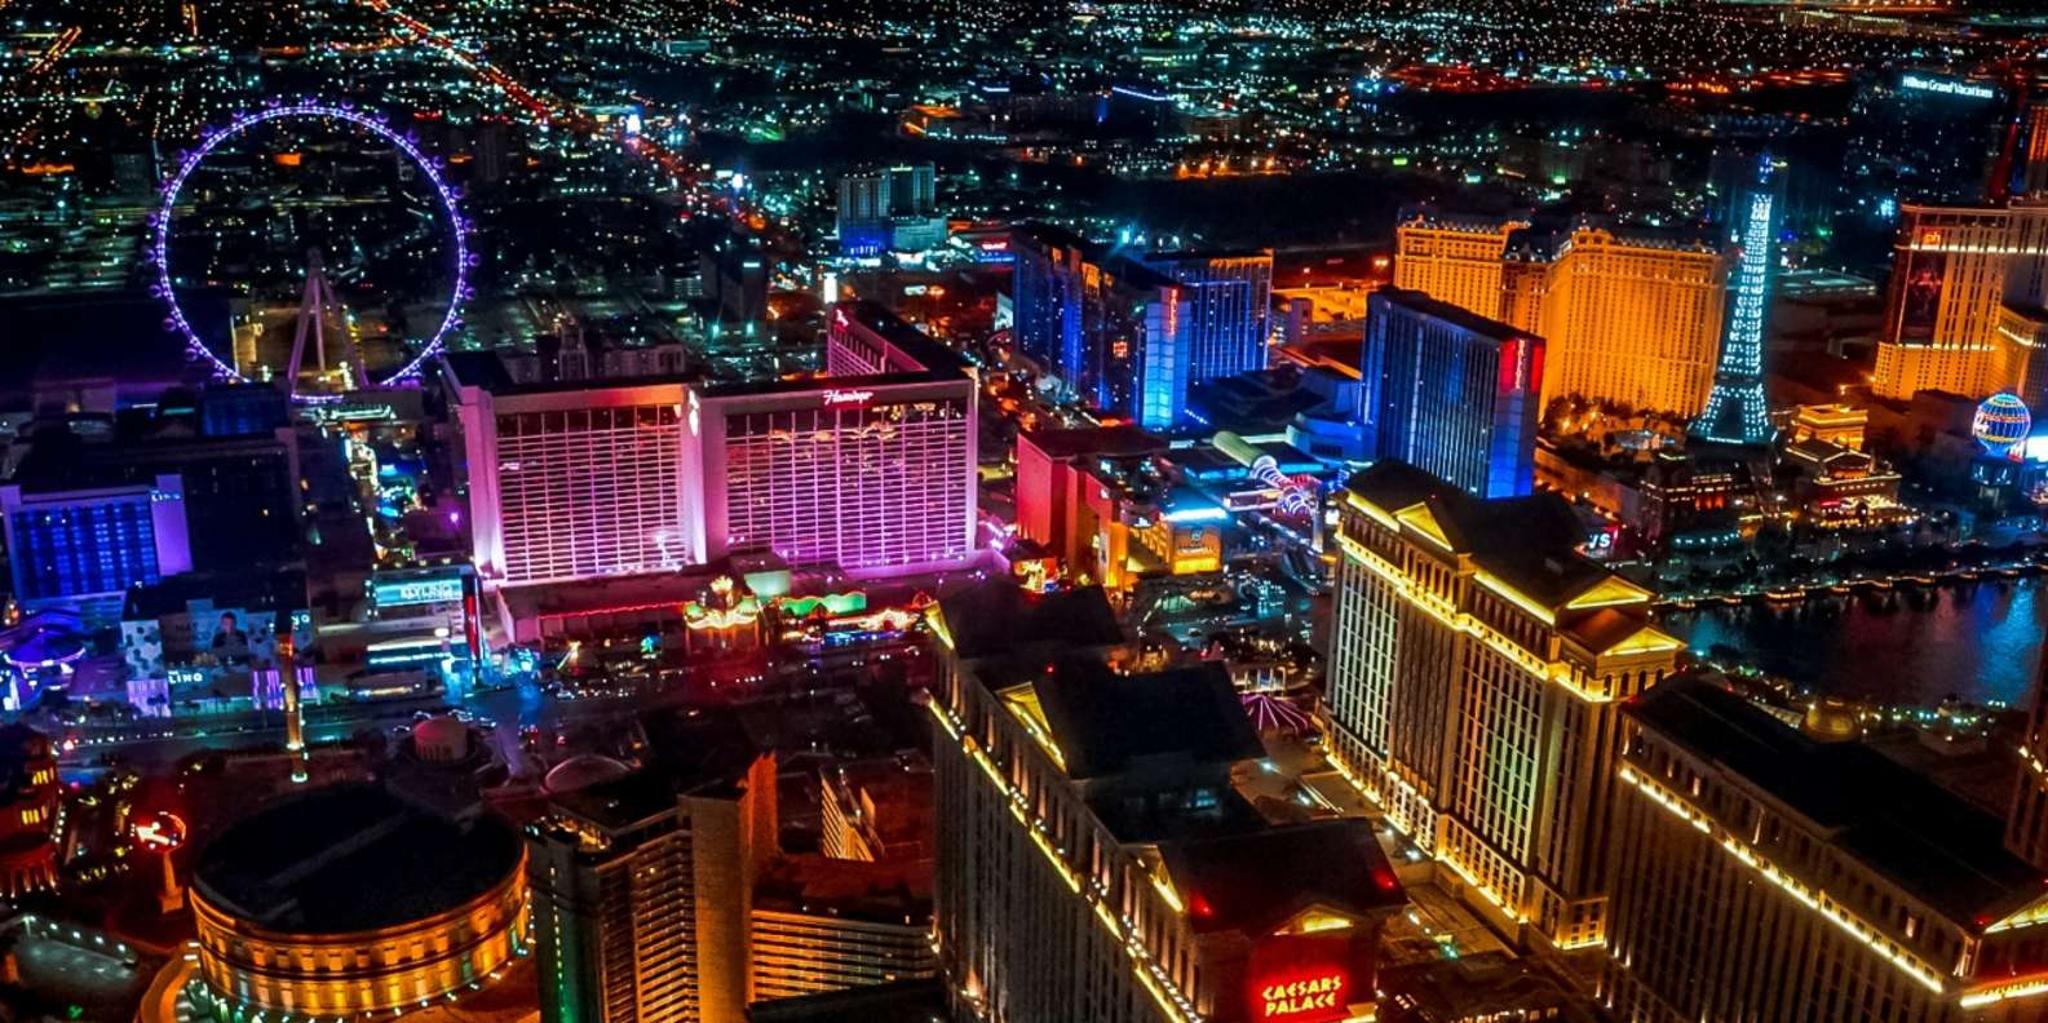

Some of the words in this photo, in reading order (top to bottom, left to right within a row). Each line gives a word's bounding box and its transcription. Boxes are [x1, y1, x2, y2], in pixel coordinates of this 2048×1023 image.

[1929, 79, 1953, 93] Grand
[1954, 83, 1993, 98] Vacations
[1262, 976, 1342, 1001] CAESARS
[1265, 992, 1335, 1017] PALACE
